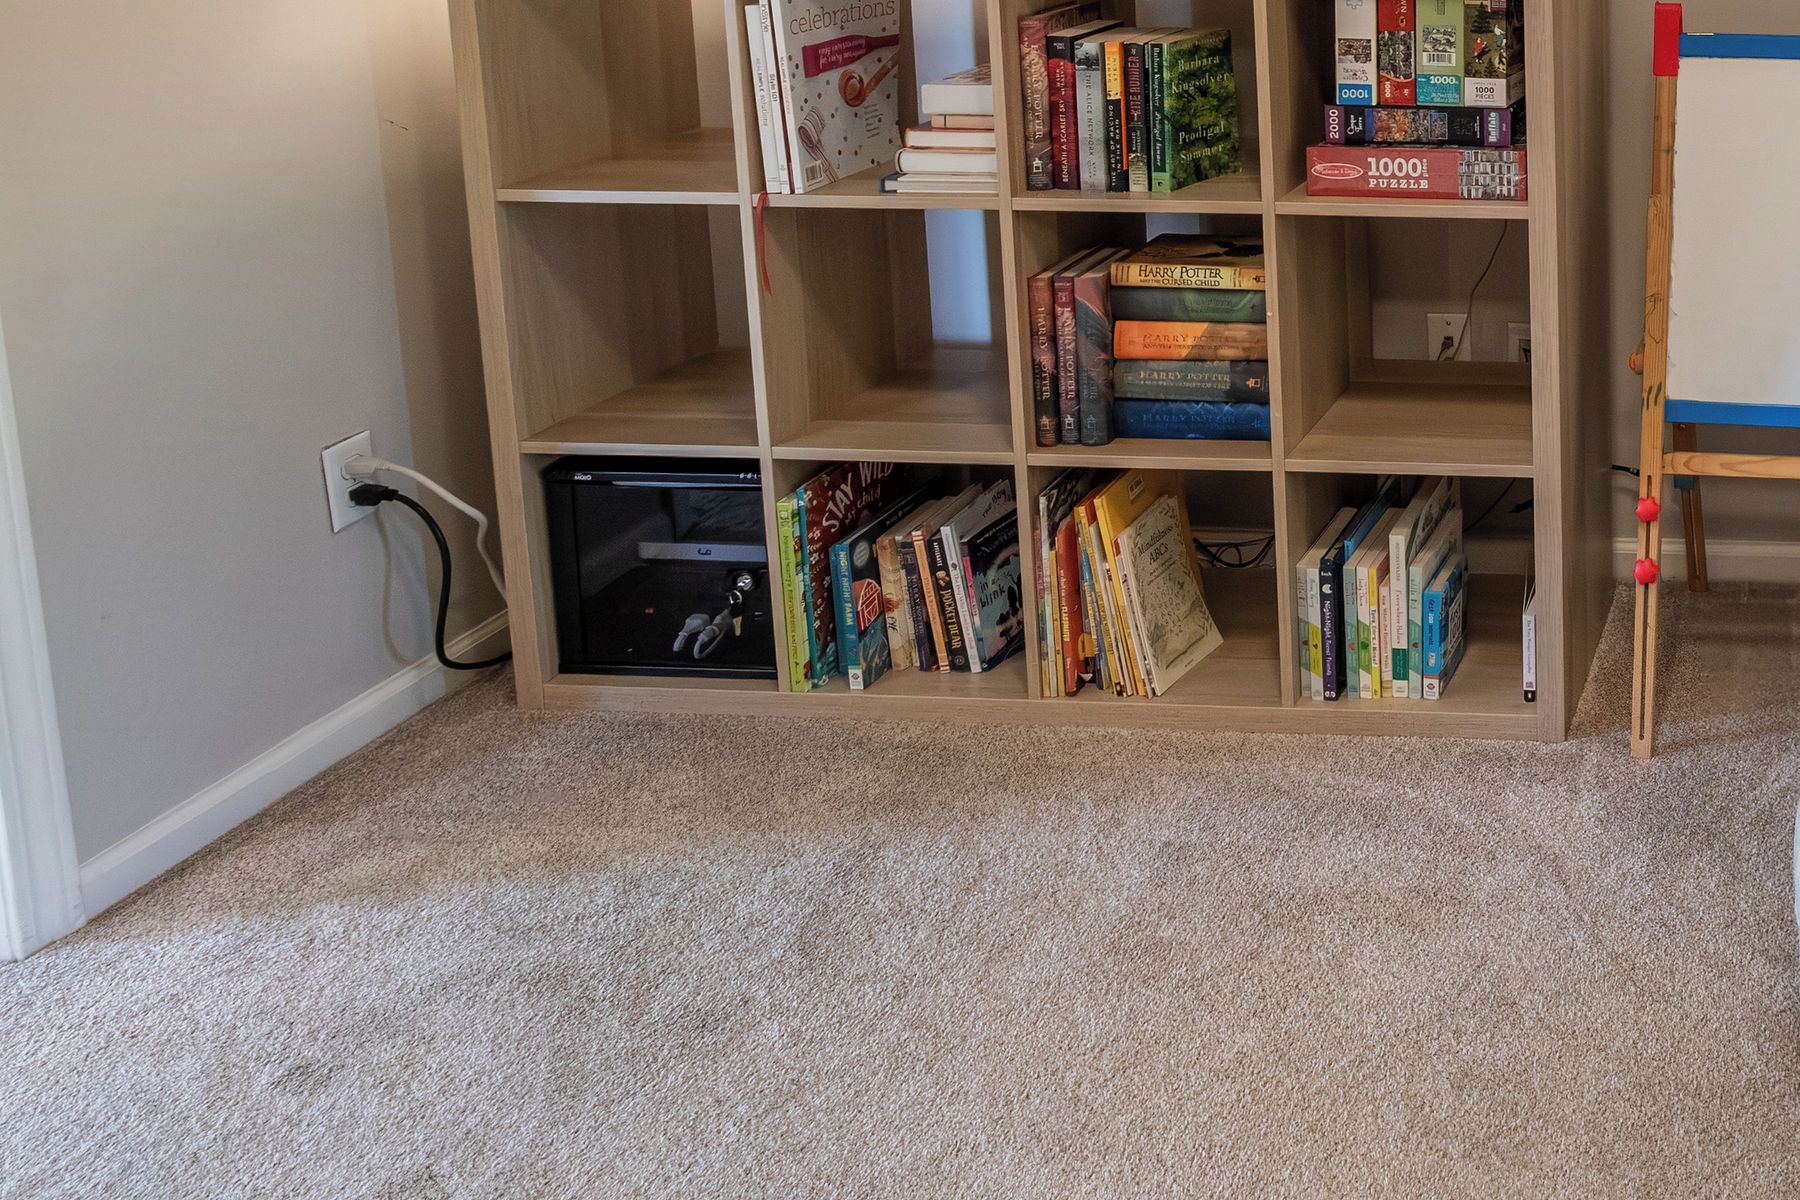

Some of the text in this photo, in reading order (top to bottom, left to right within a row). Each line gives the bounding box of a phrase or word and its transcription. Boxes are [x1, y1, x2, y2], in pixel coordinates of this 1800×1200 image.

[790, 0, 895, 35] celebrations
[1178, 55, 1219, 72] Barbara
[1171, 72, 1228, 94] Kingsolver
[1429, 76, 1456, 84] 1000
[1475, 86, 1495, 94] 1000
[1342, 89, 1368, 98] 1000
[1033, 95, 1043, 139] POTTER
[1329, 109, 1339, 138] 2000
[1488, 112, 1498, 142] Buffalo
[1179, 120, 1225, 144] Prodigal
[1110, 141, 1115, 150] OF
[1180, 144, 1224, 163] Summer
[1367, 157, 1422, 177] 1000
[1369, 179, 1428, 189] PUZZLE
[1139, 265, 1223, 279] HARRY POTTER
[1162, 278, 1192, 286] CURSED
[1194, 279, 1220, 287] CHILD
[1066, 355, 1075, 399] POTTER
[1140, 371, 1182, 379] HARRY
[822, 461, 893, 532] STAY WILD
[980, 584, 1007, 608] blink
[845, 603, 853, 625] FARM
[940, 590, 961, 649] POCKET BEAR
